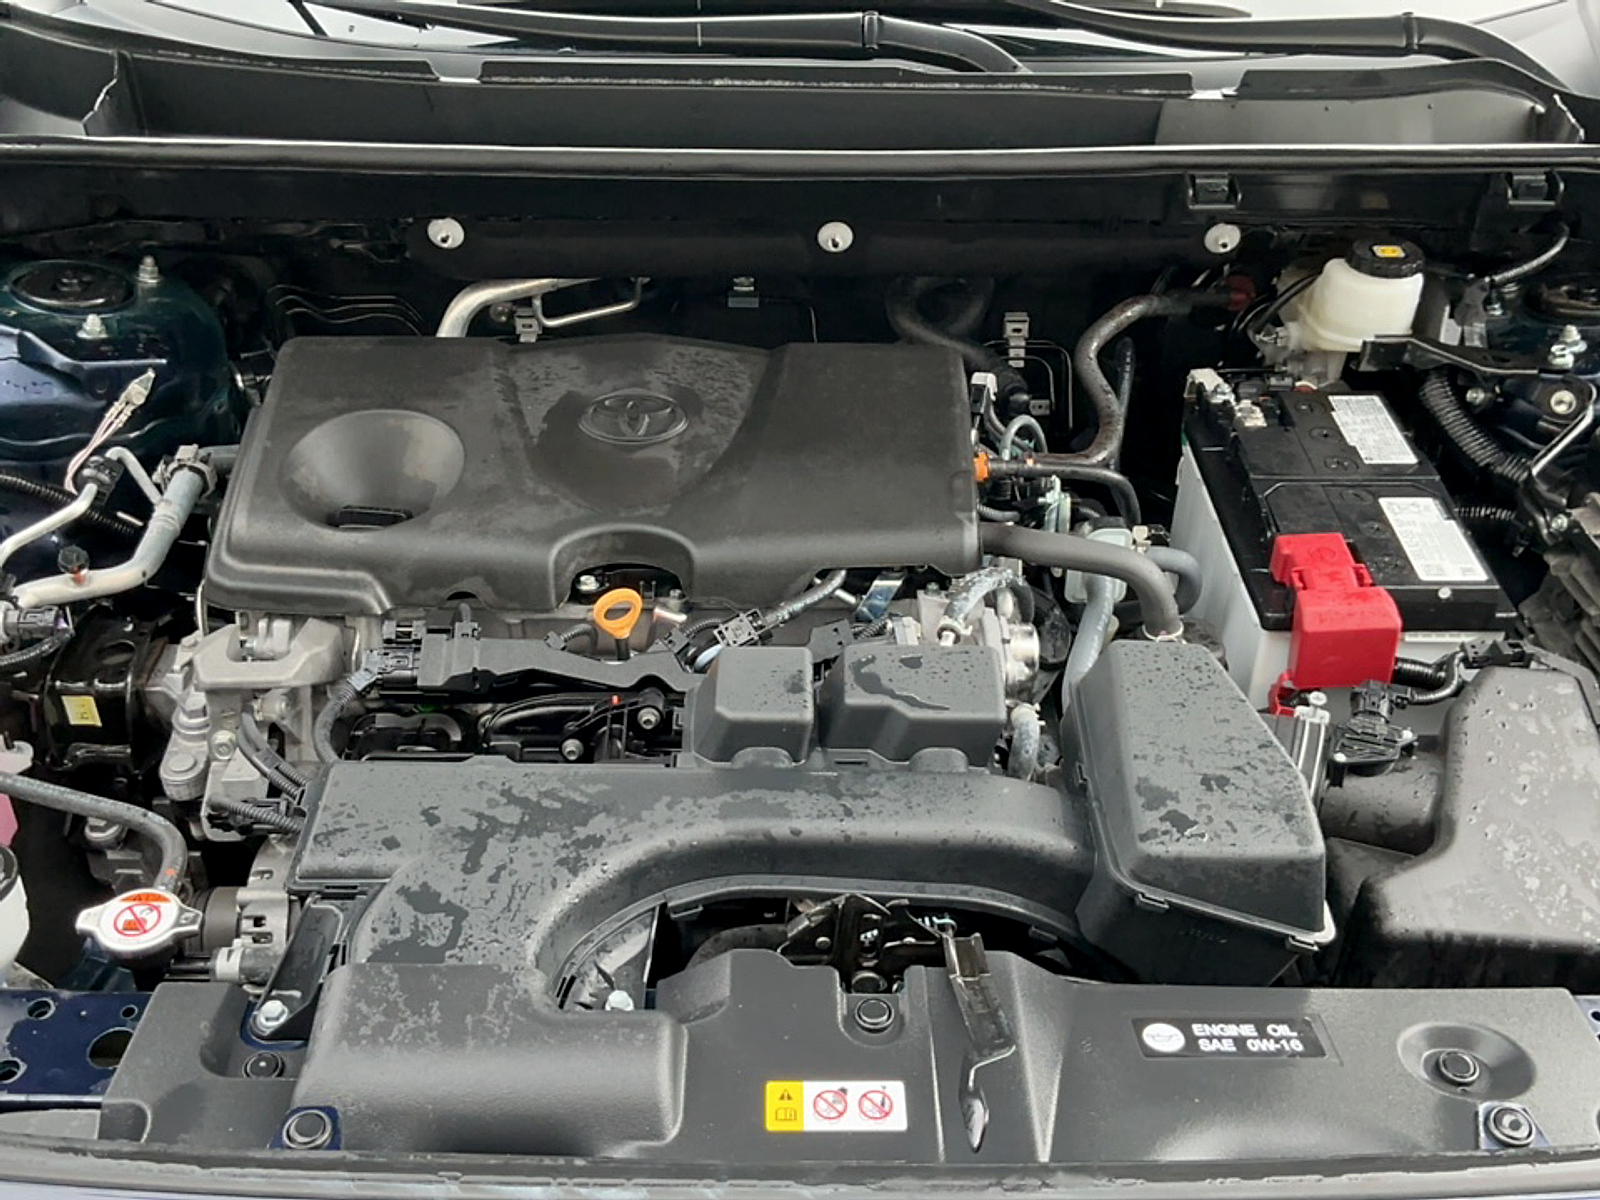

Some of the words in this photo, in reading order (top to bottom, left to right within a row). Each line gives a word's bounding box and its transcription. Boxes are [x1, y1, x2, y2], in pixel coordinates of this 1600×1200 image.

[1191, 1023, 1258, 1037] ENGINE
[1266, 1024, 1298, 1037] OIL
[1198, 1038, 1237, 1051] SAE
[1246, 1038, 1304, 1052] 0W-16
